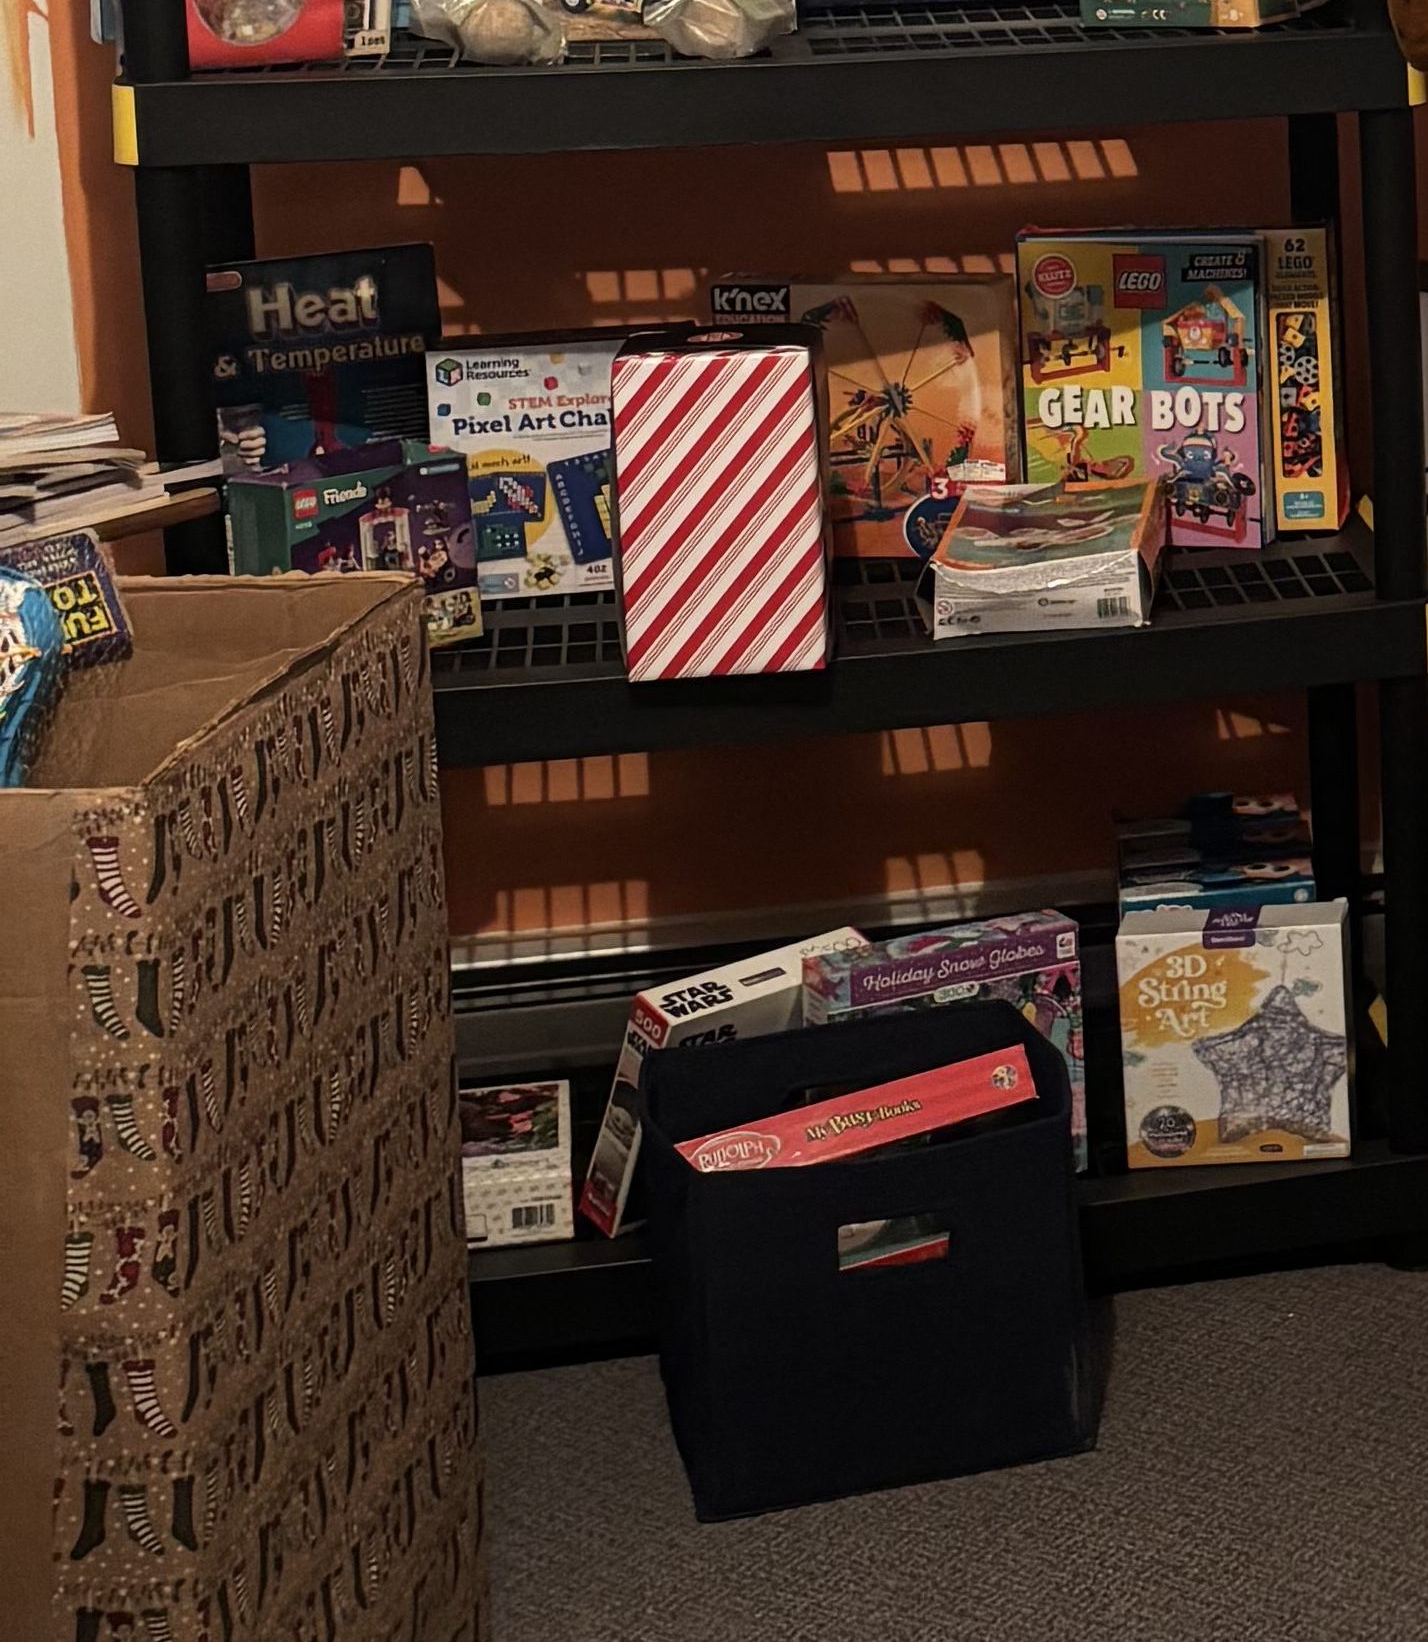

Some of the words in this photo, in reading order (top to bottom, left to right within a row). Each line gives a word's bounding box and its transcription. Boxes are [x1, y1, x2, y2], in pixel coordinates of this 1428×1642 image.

[1283, 237, 1306, 253] 62
[1193, 253, 1234, 268] CREATE
[1277, 255, 1313, 270] LEGO
[1037, 269, 1073, 282] KLUTZ
[1118, 270, 1163, 292] LEGO
[249, 276, 379, 334] Heat
[213, 356, 237, 378] &
[247, 334, 426, 373] Temperature
[466, 358, 520, 371] Learning
[466, 369, 531, 381] Resources
[507, 396, 554, 410] STEM
[1037, 384, 1136, 429] GEAR
[1150, 385, 1246, 433] BOTS
[452, 414, 512, 436] Pixel
[517, 413, 557, 432] Art
[294, 496, 318, 511] LEGO
[322, 481, 370, 505] Friends
[931, 477, 949, 499] 3
[52, 578, 99, 612] TO
[862, 966, 936, 993] Holiday
[936, 955, 986, 981] Snow
[988, 942, 1046, 971] Globes
[1165, 954, 1208, 979] 3D
[659, 981, 732, 1009] STAR
[663, 989, 735, 1019] WARS
[1137, 976, 1228, 1009] String
[633, 1008, 661, 1040] 500
[1153, 1007, 1212, 1038] Art
[806, 1126, 829, 1144] My
[829, 1110, 873, 1137] Busy
